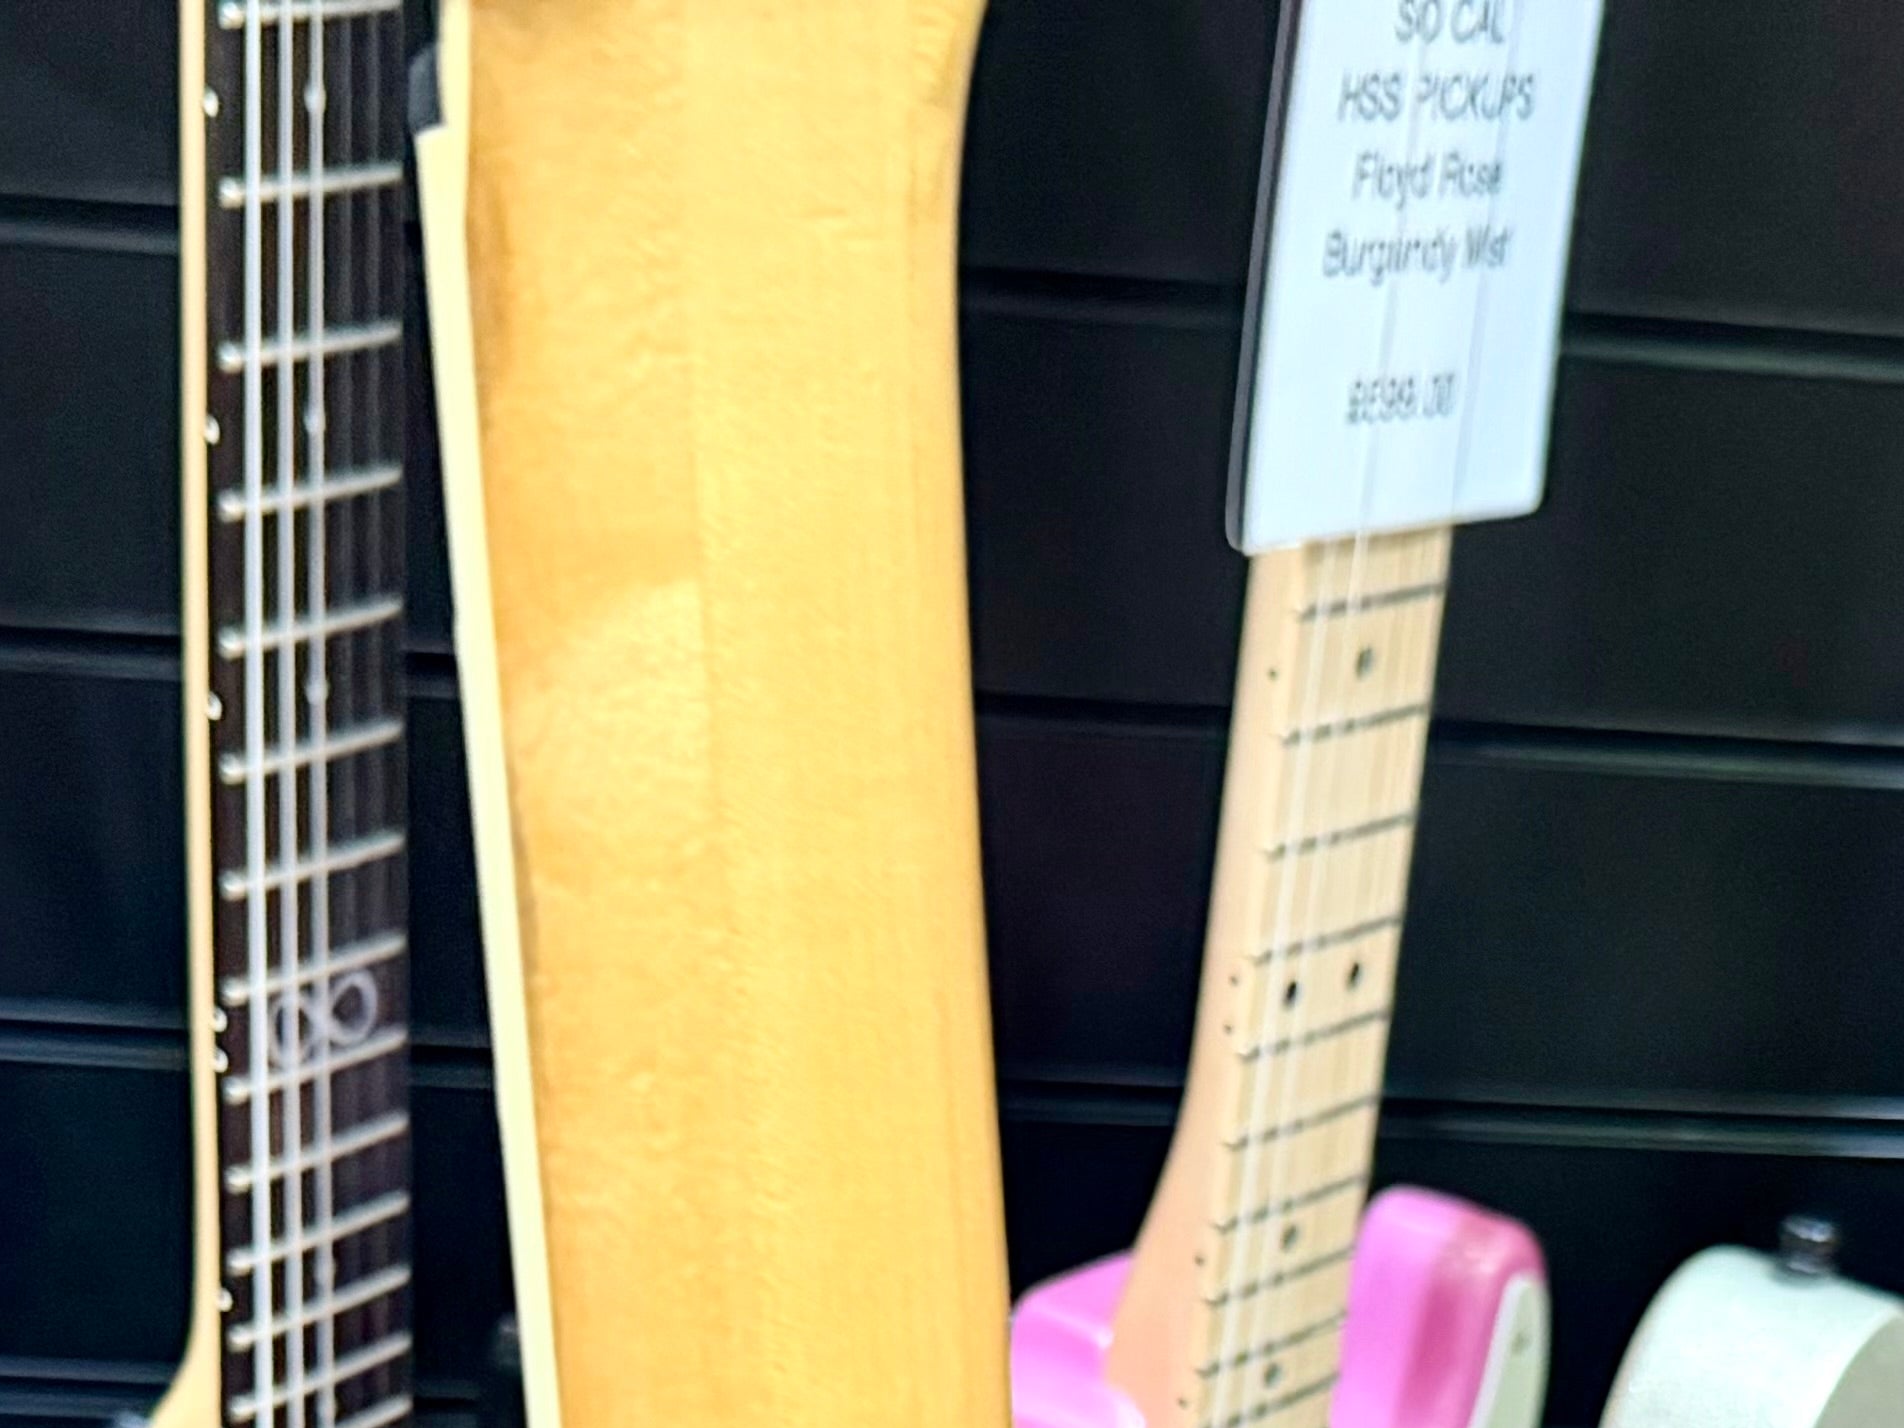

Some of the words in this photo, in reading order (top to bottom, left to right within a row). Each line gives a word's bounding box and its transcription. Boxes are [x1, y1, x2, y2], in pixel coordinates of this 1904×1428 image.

[1337, 68, 1401, 122] HSS
[1416, 66, 1536, 121] PICKUPS
[1352, 149, 1434, 211] Floyd
